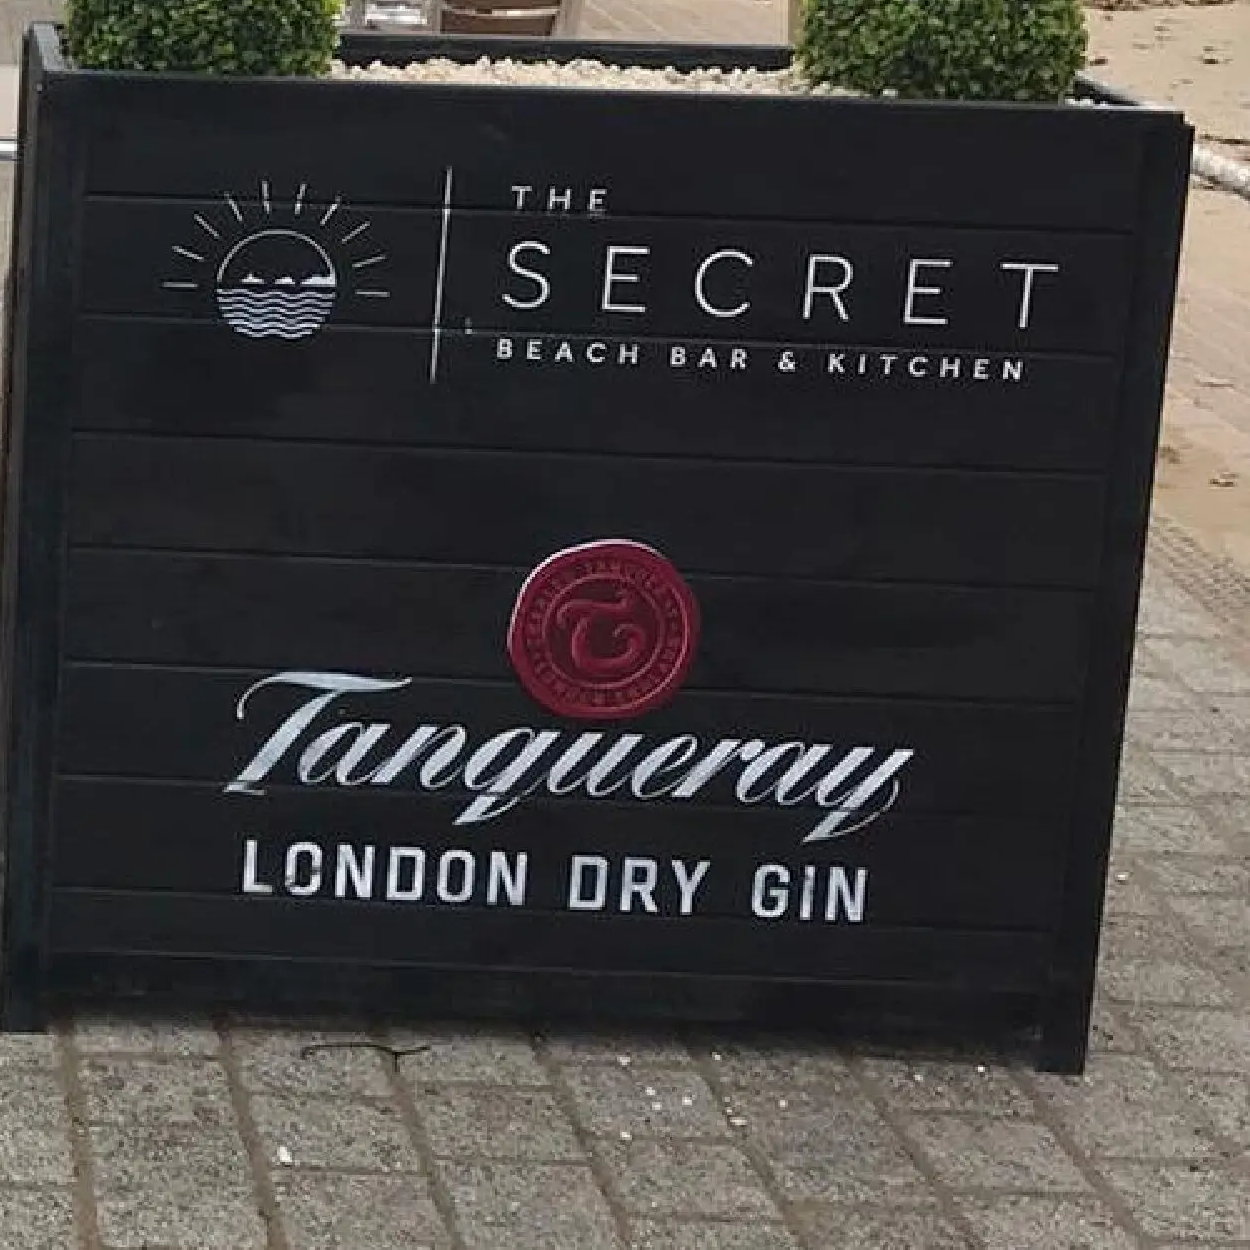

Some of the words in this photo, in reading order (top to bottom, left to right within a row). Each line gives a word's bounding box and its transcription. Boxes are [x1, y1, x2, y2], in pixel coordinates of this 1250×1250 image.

[511, 185, 606, 215] THE
[501, 240, 1059, 328] SECRET
[496, 338, 638, 365] BEACH
[669, 346, 748, 370] BAR
[777, 351, 796, 373] &
[827, 353, 1024, 380] KITCHEN
[225, 672, 914, 842] Tanqueray
[243, 839, 528, 906] LONDON
[569, 854, 711, 915] DRY
[751, 864, 866, 923] GIN
